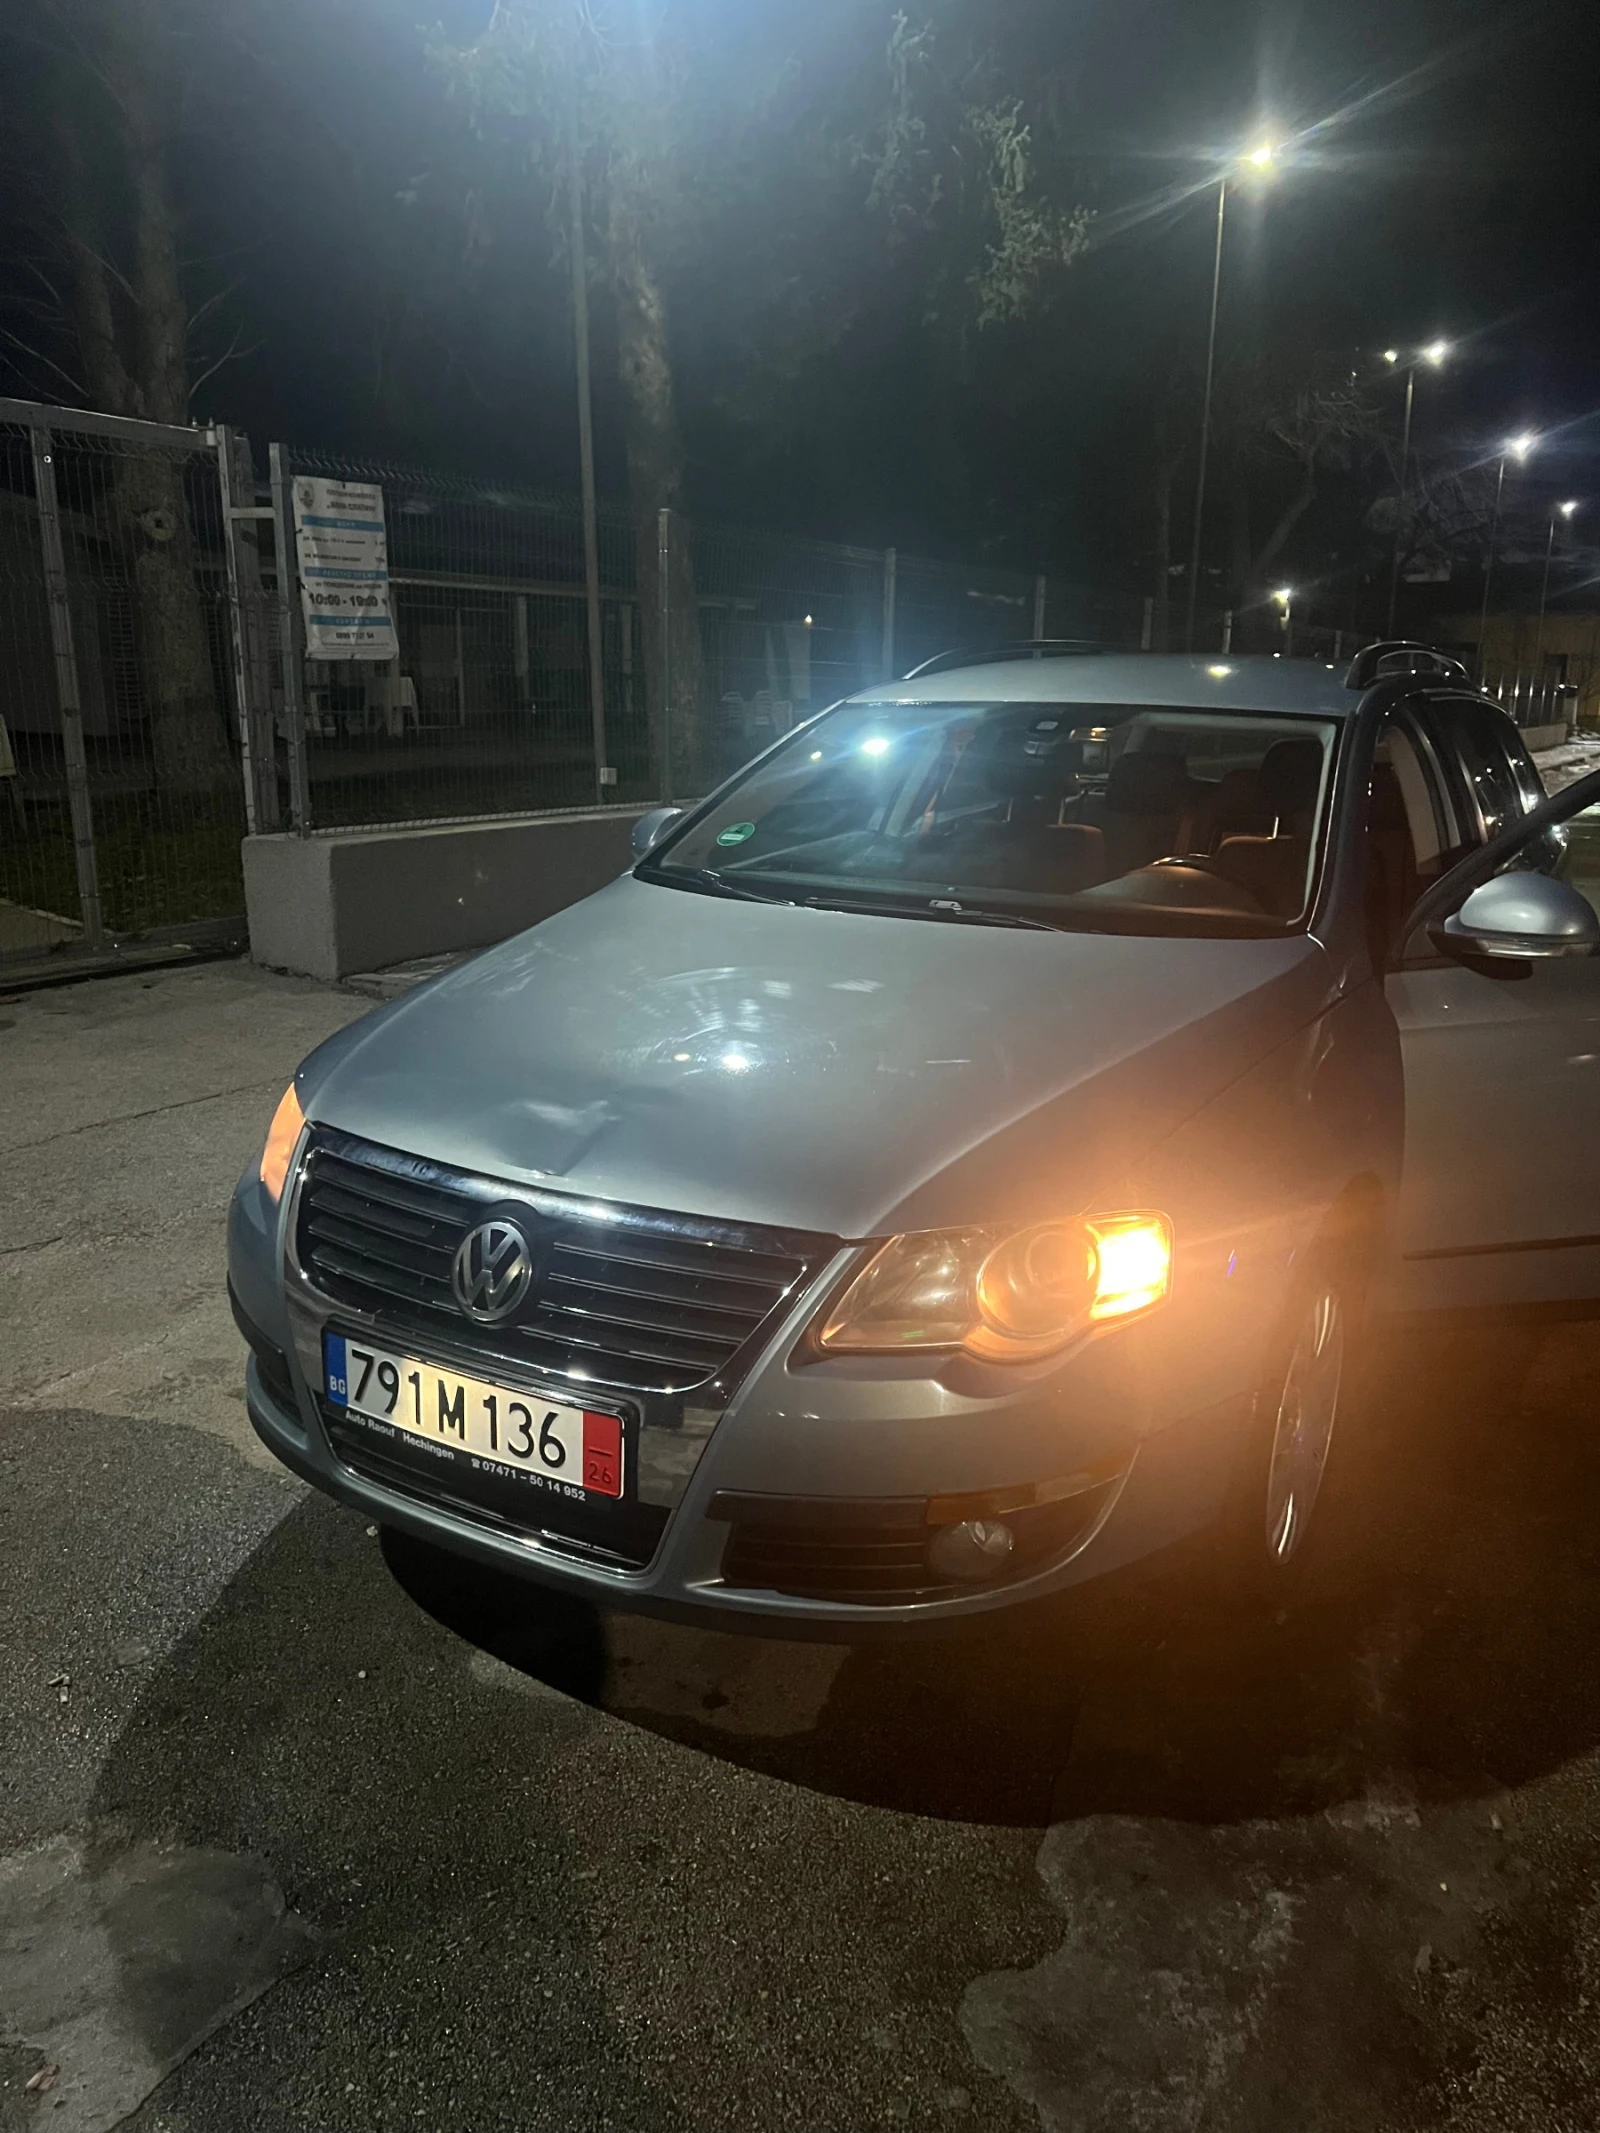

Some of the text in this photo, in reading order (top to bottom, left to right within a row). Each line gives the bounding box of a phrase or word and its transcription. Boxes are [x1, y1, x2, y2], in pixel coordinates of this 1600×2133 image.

[459, 1225, 527, 1315] VW
[329, 1375, 346, 1395] BG
[351, 1348, 566, 1469] 791 M 136
[345, 1409, 455, 1460] Auto Raouf Hechingen
[482, 1460, 517, 1480] 07471
[529, 1474, 543, 1488] 50
[547, 1480, 561, 1494] 14
[563, 1486, 586, 1502] 952
[588, 1461, 612, 1485] 26
